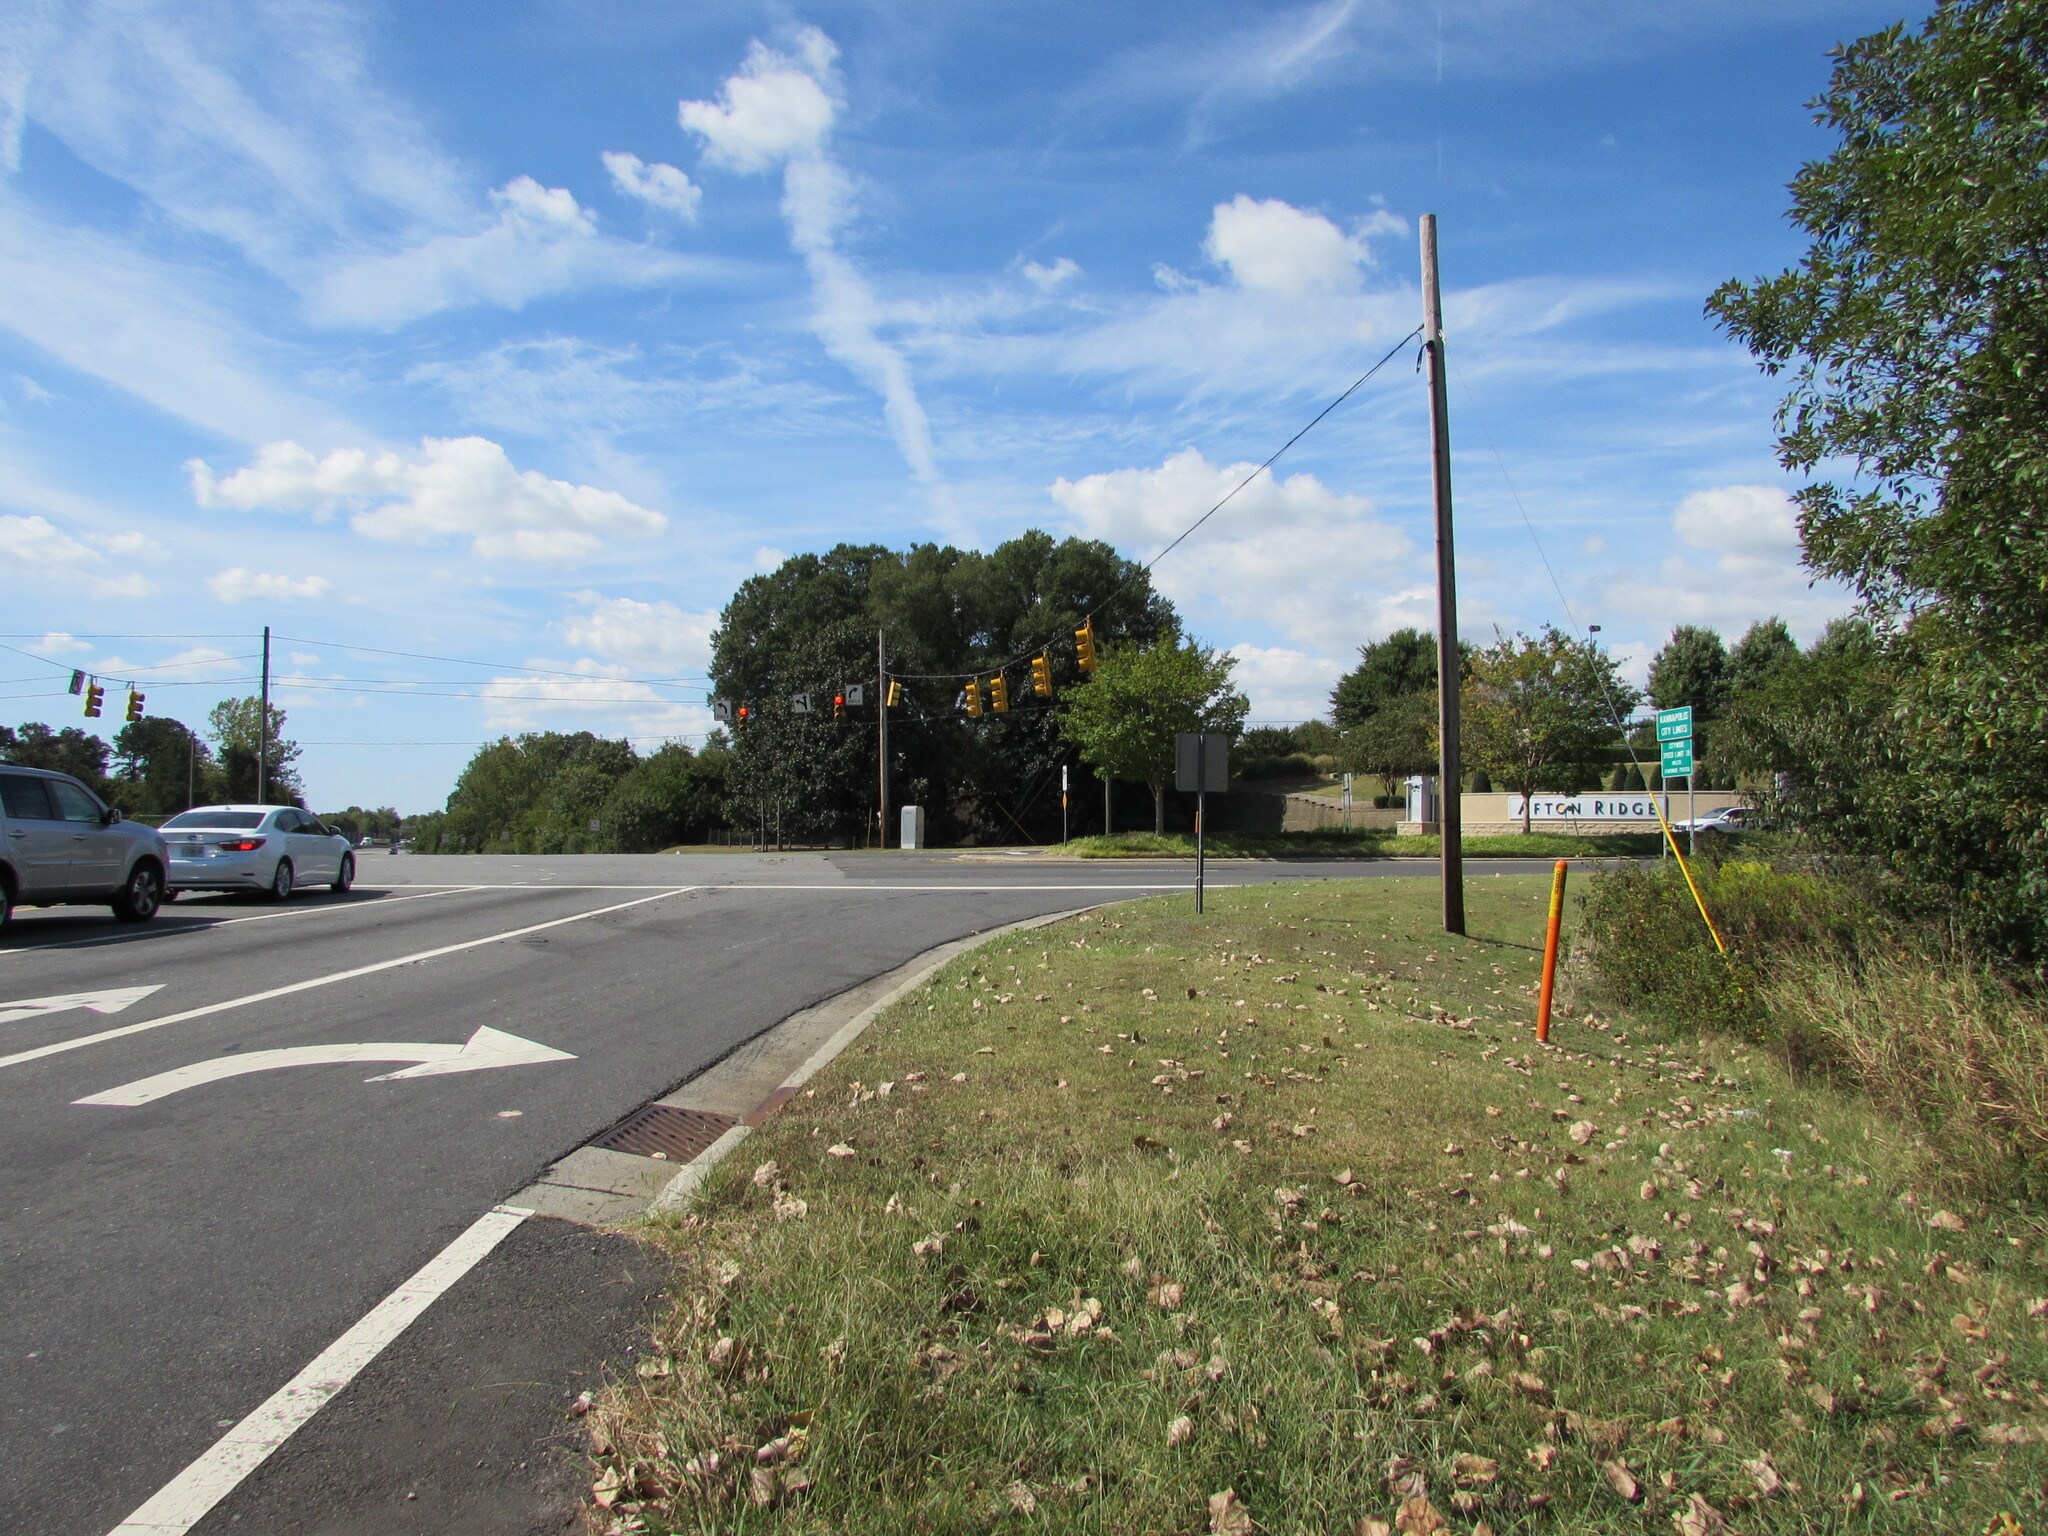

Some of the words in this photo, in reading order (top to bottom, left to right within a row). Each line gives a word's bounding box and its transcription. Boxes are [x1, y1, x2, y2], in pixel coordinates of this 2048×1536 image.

[1661, 727, 1671, 736] CITY
[1672, 724, 1688, 735] LIMITS
[1595, 800, 1656, 815] RIDGE
